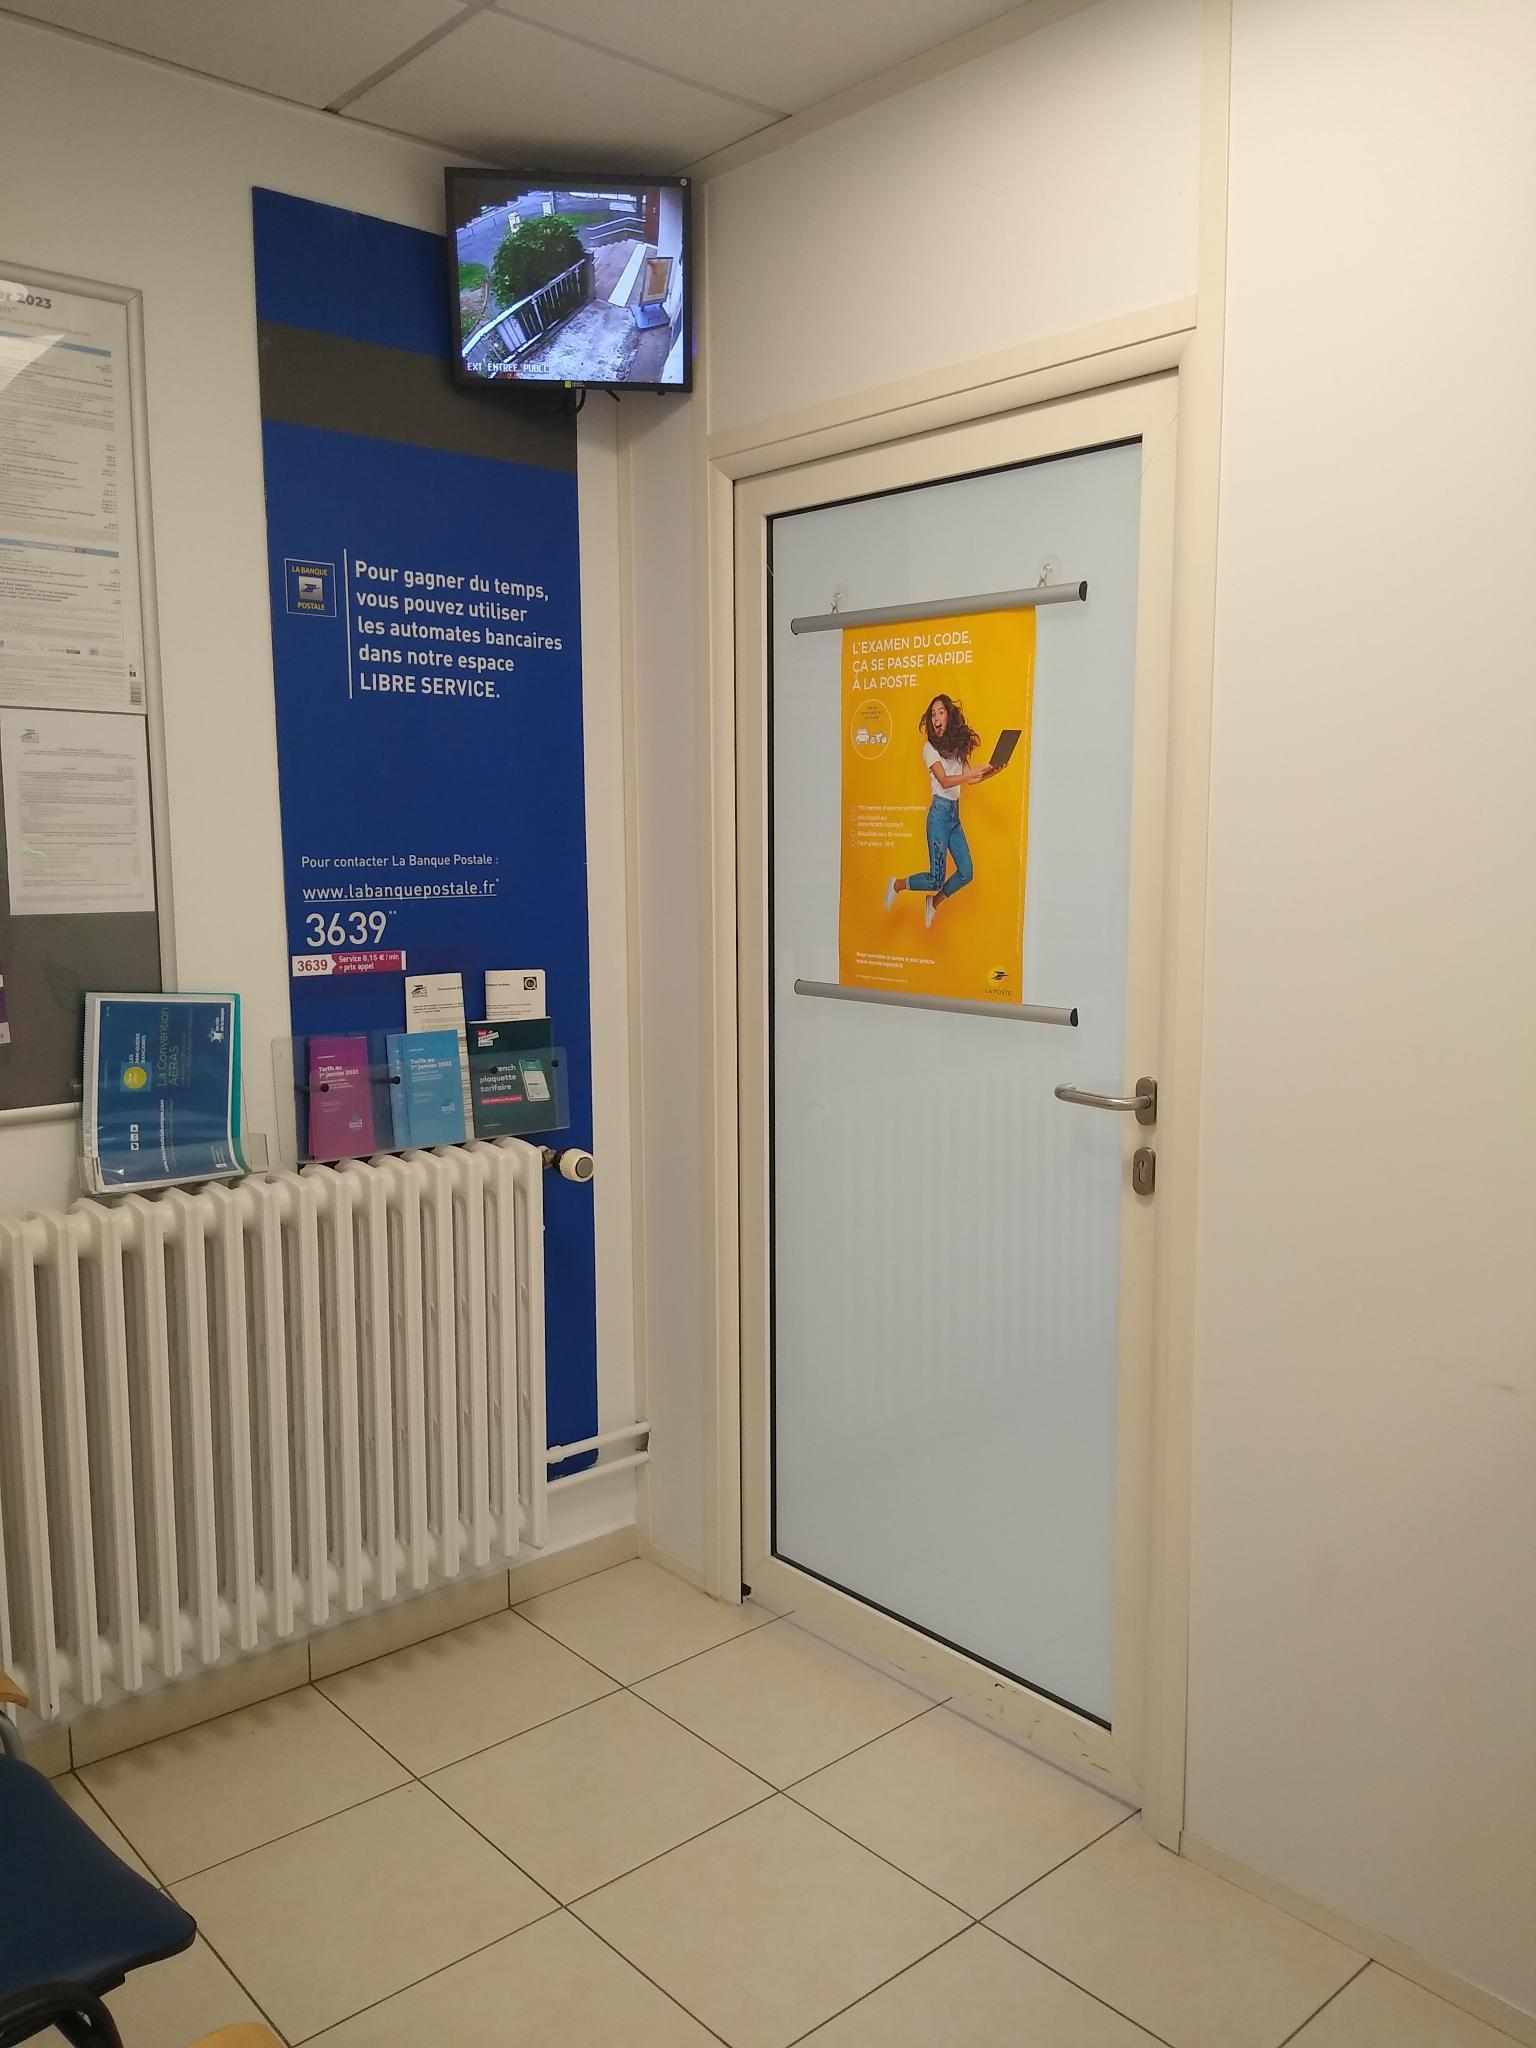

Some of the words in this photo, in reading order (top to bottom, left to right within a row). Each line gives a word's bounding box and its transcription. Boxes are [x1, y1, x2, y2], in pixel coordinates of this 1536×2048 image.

[467, 362, 482, 371] EXT
[488, 363, 518, 372] ENTREE
[292, 565, 300, 574] LA
[300, 566, 328, 576] BANQUE
[355, 560, 399, 580] Pour
[404, 569, 465, 591] gagner
[469, 574, 490, 593] du
[494, 577, 549, 602] temps,
[297, 601, 326, 611] POSTALE
[356, 592, 399, 609] vous
[404, 597, 464, 616] pouvez
[468, 600, 528, 622] utiliser
[358, 616, 385, 635] les
[390, 621, 481, 644] automates
[485, 627, 562, 650] bancaires
[852, 636, 910, 655] L'EXAMEN
[913, 634, 931, 649] DU
[359, 644, 402, 664] dans
[407, 650, 453, 668] notre
[458, 655, 514, 674] espace
[852, 659, 868, 674] ÇA
[871, 658, 884, 671] SE
[887, 654, 924, 670] PASSE
[927, 650, 973, 666] RAPIDE
[360, 673, 416, 694] LIBRE
[421, 676, 500, 699] SERVICE.
[852, 672, 861, 691] À
[864, 677, 877, 690] LA
[880, 674, 919, 689] POSTE.
[302, 856, 331, 868] Pour
[334, 856, 388, 868] contacter
[392, 856, 406, 866] La
[408, 855, 451, 868] Banque
[454, 854, 493, 866] Postale
[297, 959, 328, 972] 3639
[338, 954, 362, 964] Service
[362, 954, 378, 962] 0,15
[344, 963, 356, 972] prix
[358, 962, 375, 972] appel
[157, 1008, 169, 1070] Convention
[169, 1046, 180, 1086] AERAS
[158, 1072, 168, 1086] La
[480, 1074, 516, 1084] plaquette
[480, 1084, 512, 1092] tarifaire
